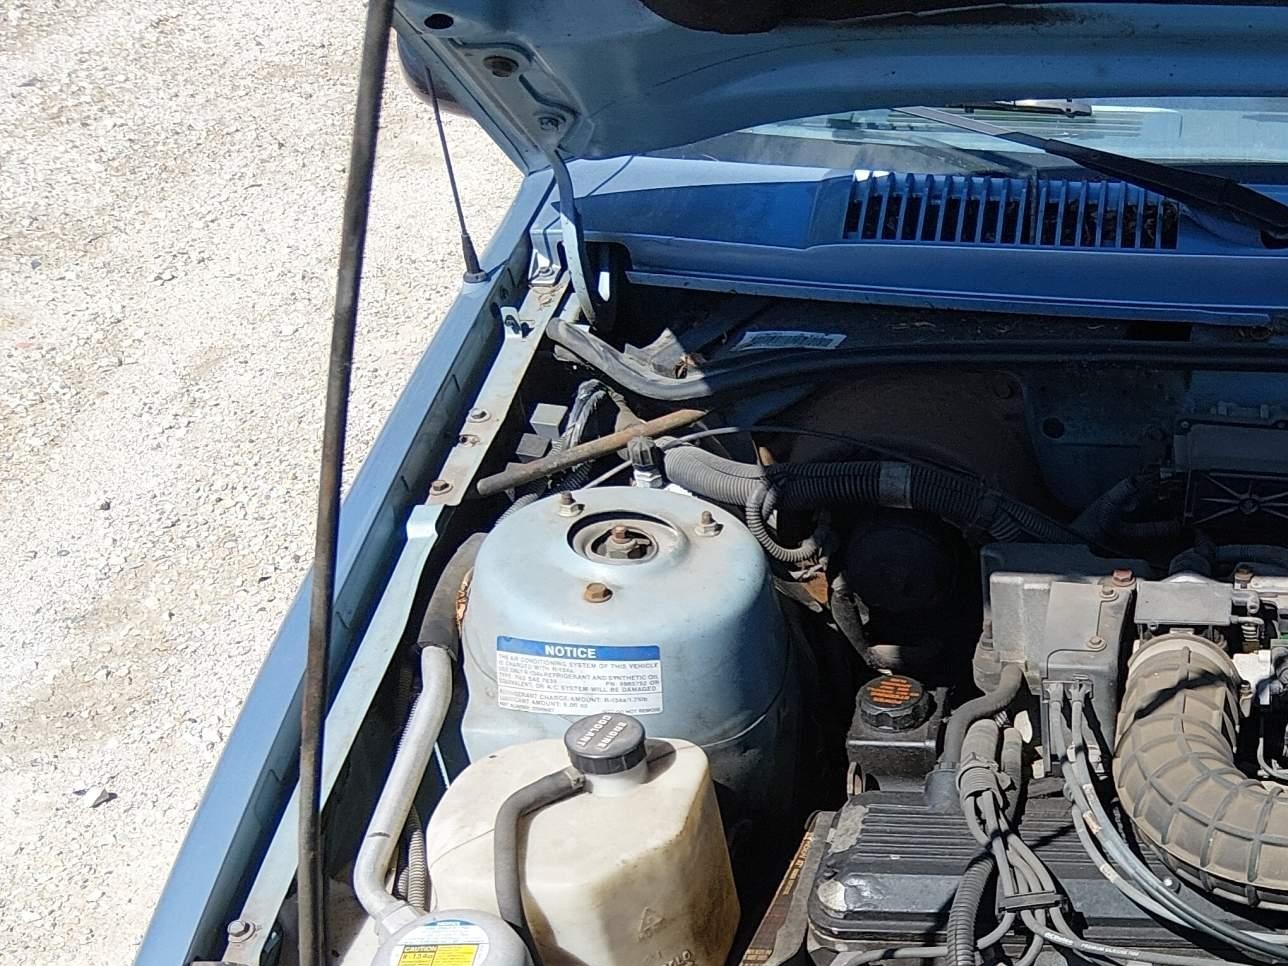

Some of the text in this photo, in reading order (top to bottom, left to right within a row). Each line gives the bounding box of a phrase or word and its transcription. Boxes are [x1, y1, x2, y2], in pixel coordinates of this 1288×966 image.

[544, 645, 597, 659] NOTICE
[569, 661, 597, 669] SYSTEM
[576, 714, 612, 747] COOLANT
